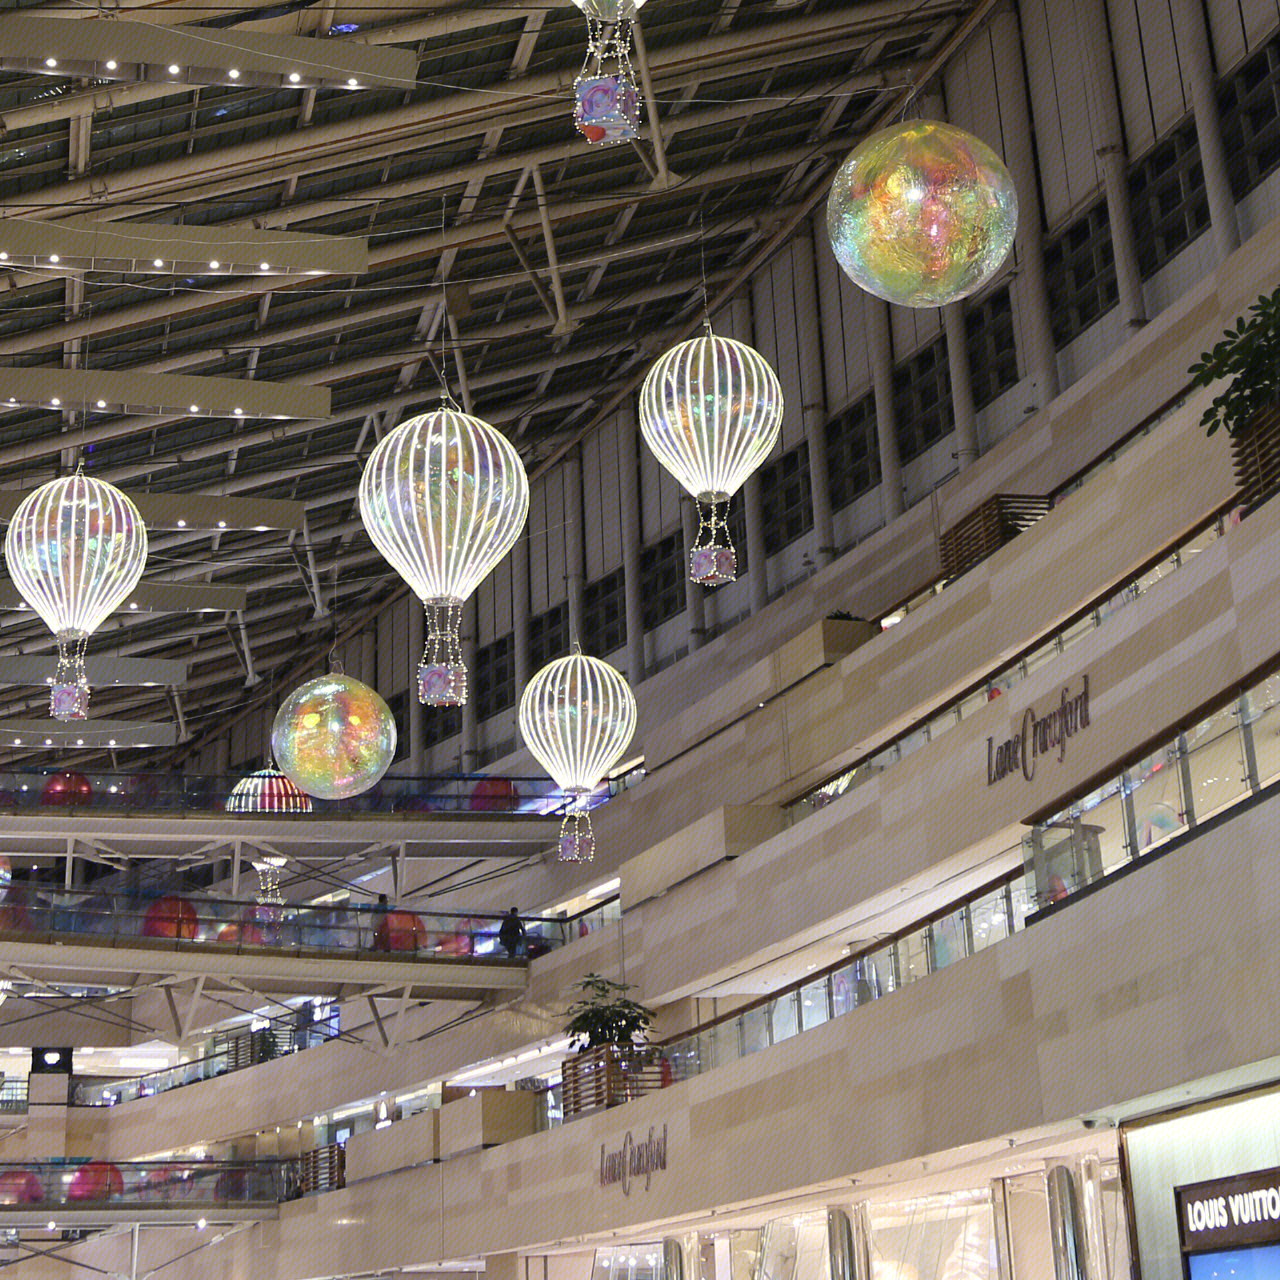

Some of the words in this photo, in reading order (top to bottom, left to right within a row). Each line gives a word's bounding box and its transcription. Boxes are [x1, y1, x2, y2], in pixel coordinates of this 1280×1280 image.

[987, 734, 1021, 786] Lane
[1021, 674, 1090, 782] Crawford
[1187, 1196, 1228, 1232] LOUIS
